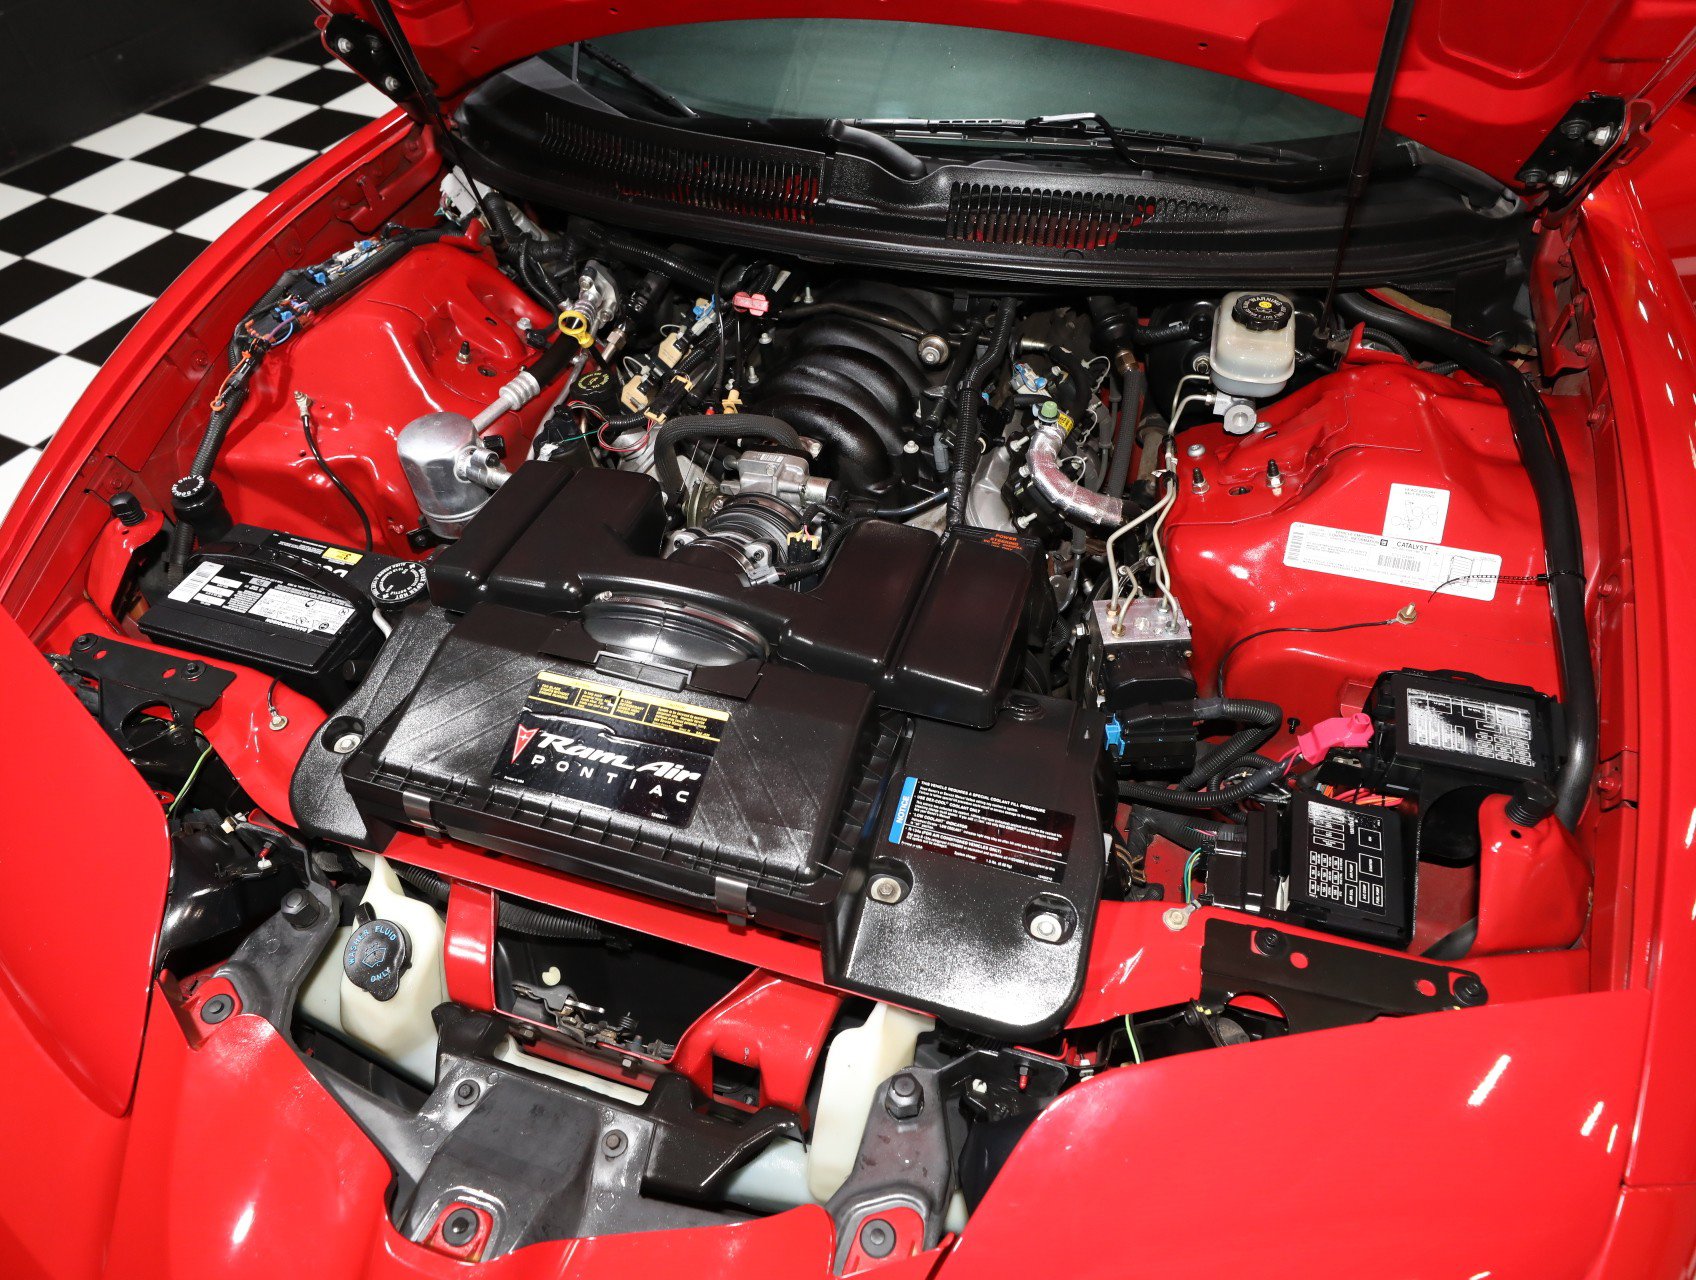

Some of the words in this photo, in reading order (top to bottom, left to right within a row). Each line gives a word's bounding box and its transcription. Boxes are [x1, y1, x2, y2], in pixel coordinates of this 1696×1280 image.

[177, 474, 197, 483] ONLY
[1396, 541, 1428, 551] CATALYST
[538, 732, 636, 770] Ram
[636, 761, 701, 782] Air
[531, 754, 689, 803] PONTIAC
[930, 782, 947, 790] VEHICLE
[947, 786, 968, 795] REQUIRES
[972, 792, 989, 800] SPECIAL
[990, 796, 1010, 805] COOLANT
[1019, 803, 1045, 813] PROCEDURE
[949, 801, 969, 810] COOLANT
[896, 795, 910, 824] NOTICE
[939, 835, 968, 845] CONDITIONED
[968, 841, 988, 850] VEHICLES
[348, 929, 369, 966] WASHER
[375, 925, 397, 941] FLUID
[370, 967, 392, 983] ONLY
